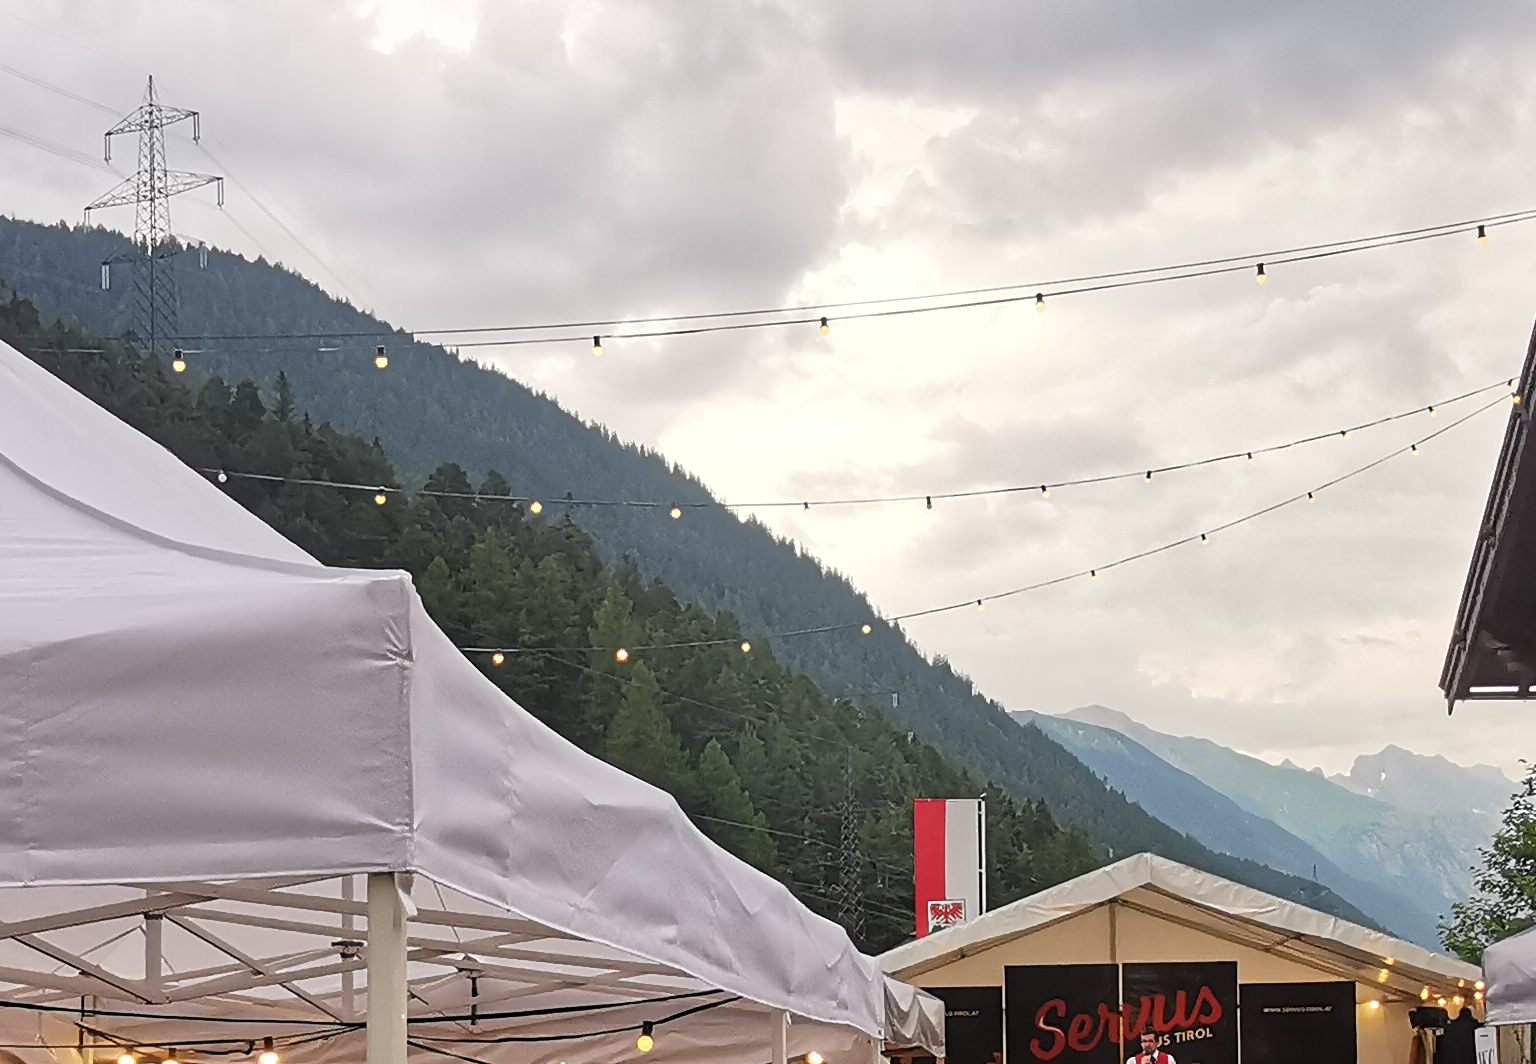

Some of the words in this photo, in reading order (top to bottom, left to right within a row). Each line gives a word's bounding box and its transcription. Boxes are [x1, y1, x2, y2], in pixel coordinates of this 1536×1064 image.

[1030, 986, 1223, 1062] Servus
[1156, 1033, 1171, 1047] US
[1174, 1027, 1214, 1044] TIROL
